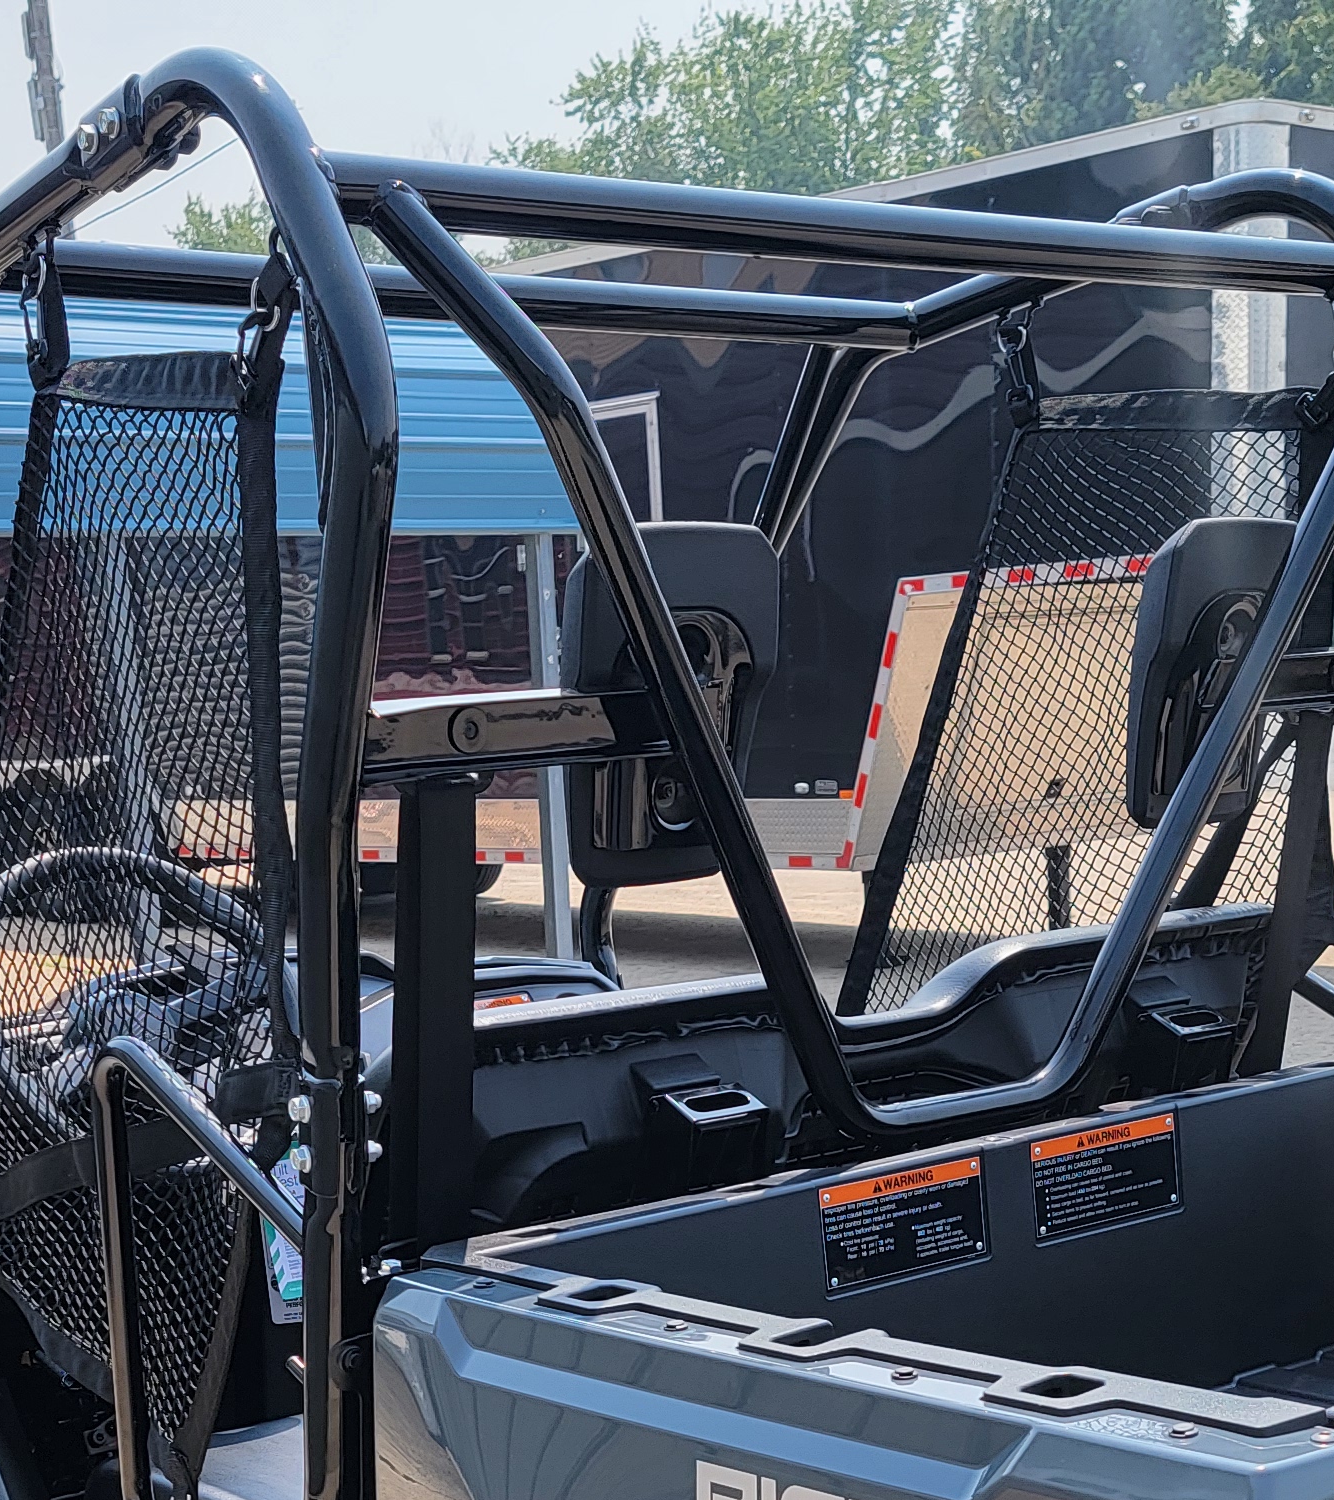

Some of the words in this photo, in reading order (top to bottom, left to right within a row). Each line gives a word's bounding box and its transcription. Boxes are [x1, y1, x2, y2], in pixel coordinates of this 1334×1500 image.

[1086, 1126, 1130, 1145] WARNING
[1080, 1148, 1097, 1158] DEATH
[1034, 1170, 1042, 1178] DO
[1043, 1167, 1054, 1176] NOT
[1054, 1164, 1066, 1173] RIDE
[1067, 1163, 1072, 1171] IN
[1073, 1159, 1091, 1169] CARGO
[1035, 1179, 1043, 1187] DO
[1043, 1177, 1054, 1185] NOT
[1055, 1170, 1082, 1183] OVERLOAD
[1082, 1166, 1101, 1176] CARGO
[883, 1169, 933, 1190] WARNING
